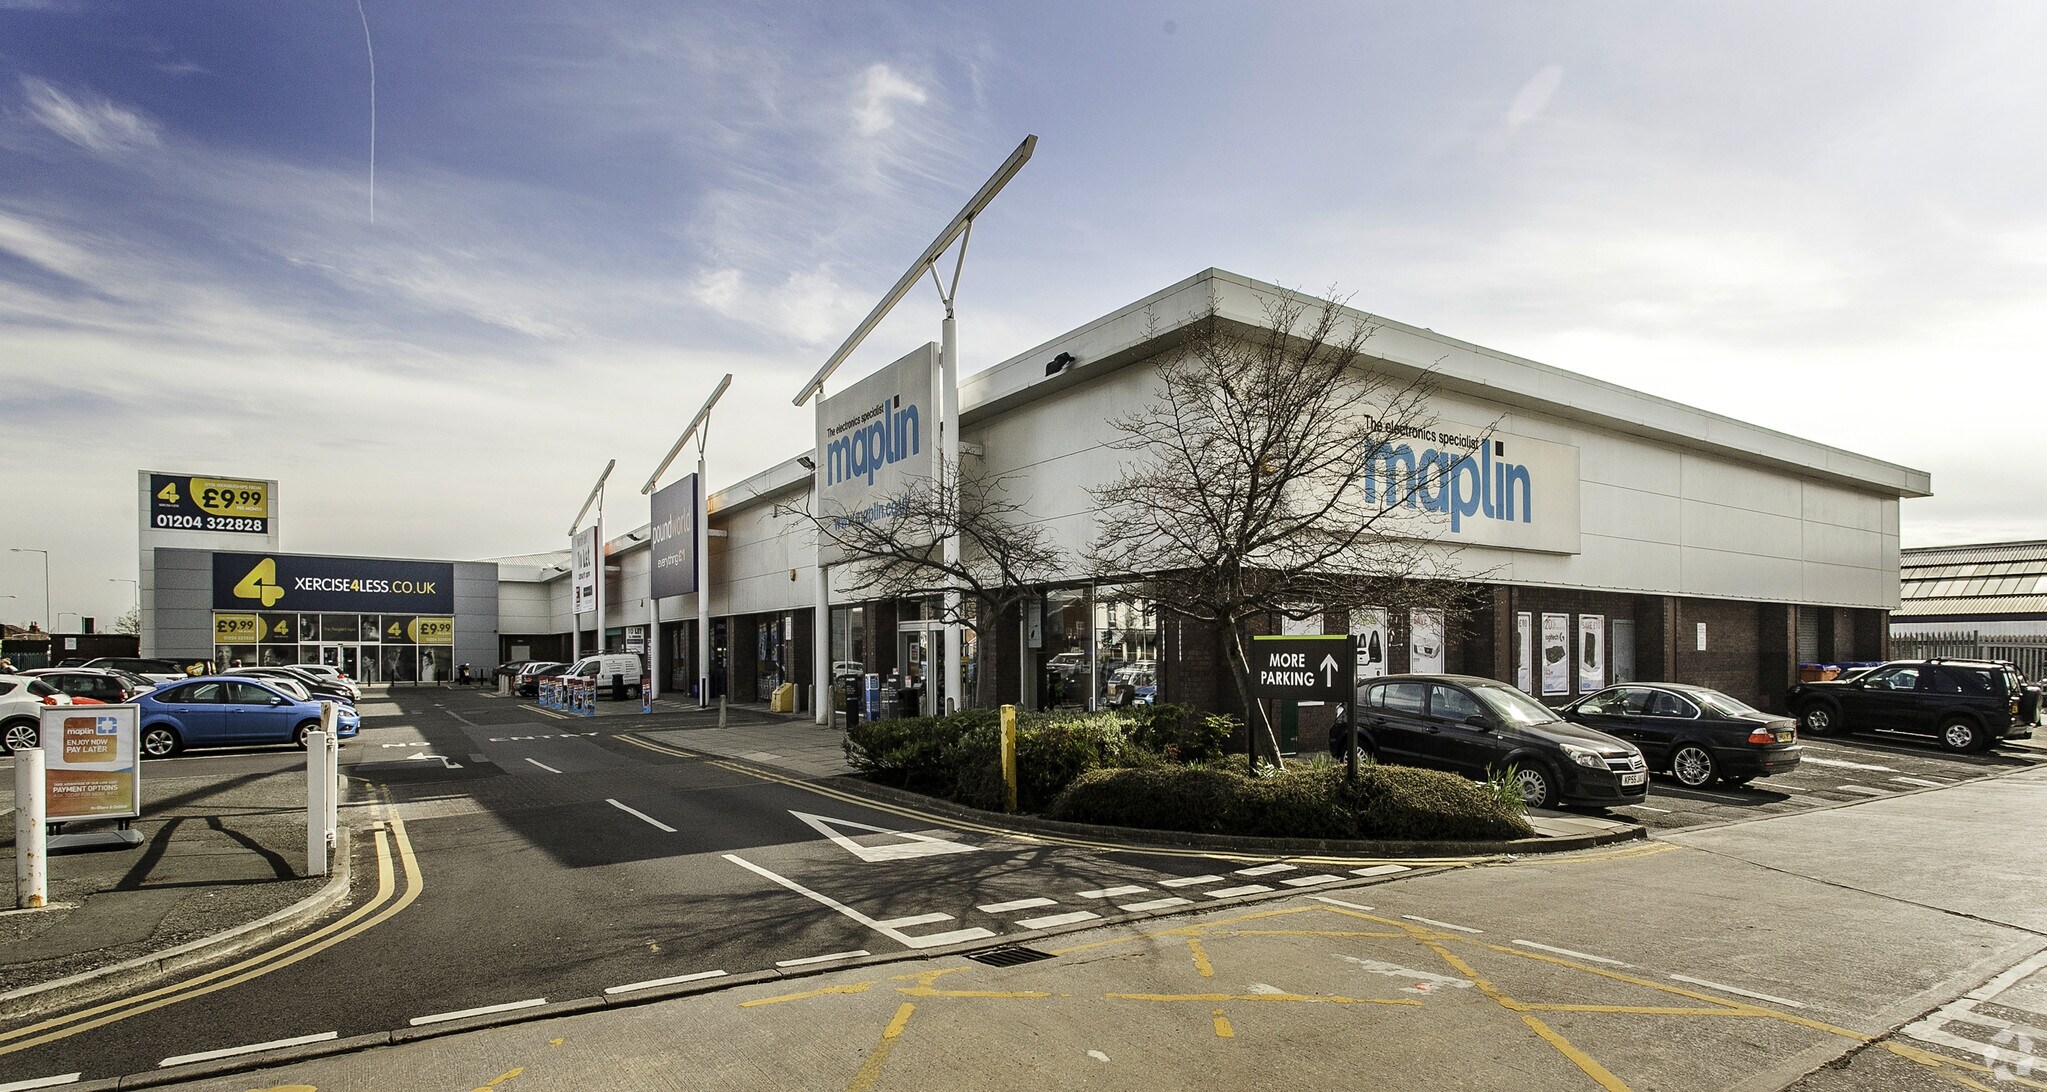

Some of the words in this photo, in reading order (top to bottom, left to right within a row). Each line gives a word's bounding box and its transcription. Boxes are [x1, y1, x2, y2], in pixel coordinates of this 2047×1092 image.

[827, 427, 836, 438] The
[836, 417, 860, 434] electronics
[861, 402, 884, 425] specialist
[827, 395, 919, 486] maplin
[1364, 414, 1383, 432] The
[1385, 420, 1437, 442] electronics
[1438, 433, 1479, 451] specialist
[1364, 437, 1532, 533] maplin
[202, 488, 262, 509] £9.99
[157, 514, 203, 528] 01204
[206, 517, 263, 531] 322828
[653, 505, 690, 551] poundworld
[657, 554, 678, 568] everything
[294, 577, 436, 594] XERCISE4LESS.CO.UK
[216, 620, 254, 633] £9.99
[420, 623, 451, 635] £9.99
[1269, 653, 1305, 667] MORE
[1261, 671, 1315, 686] PARKING
